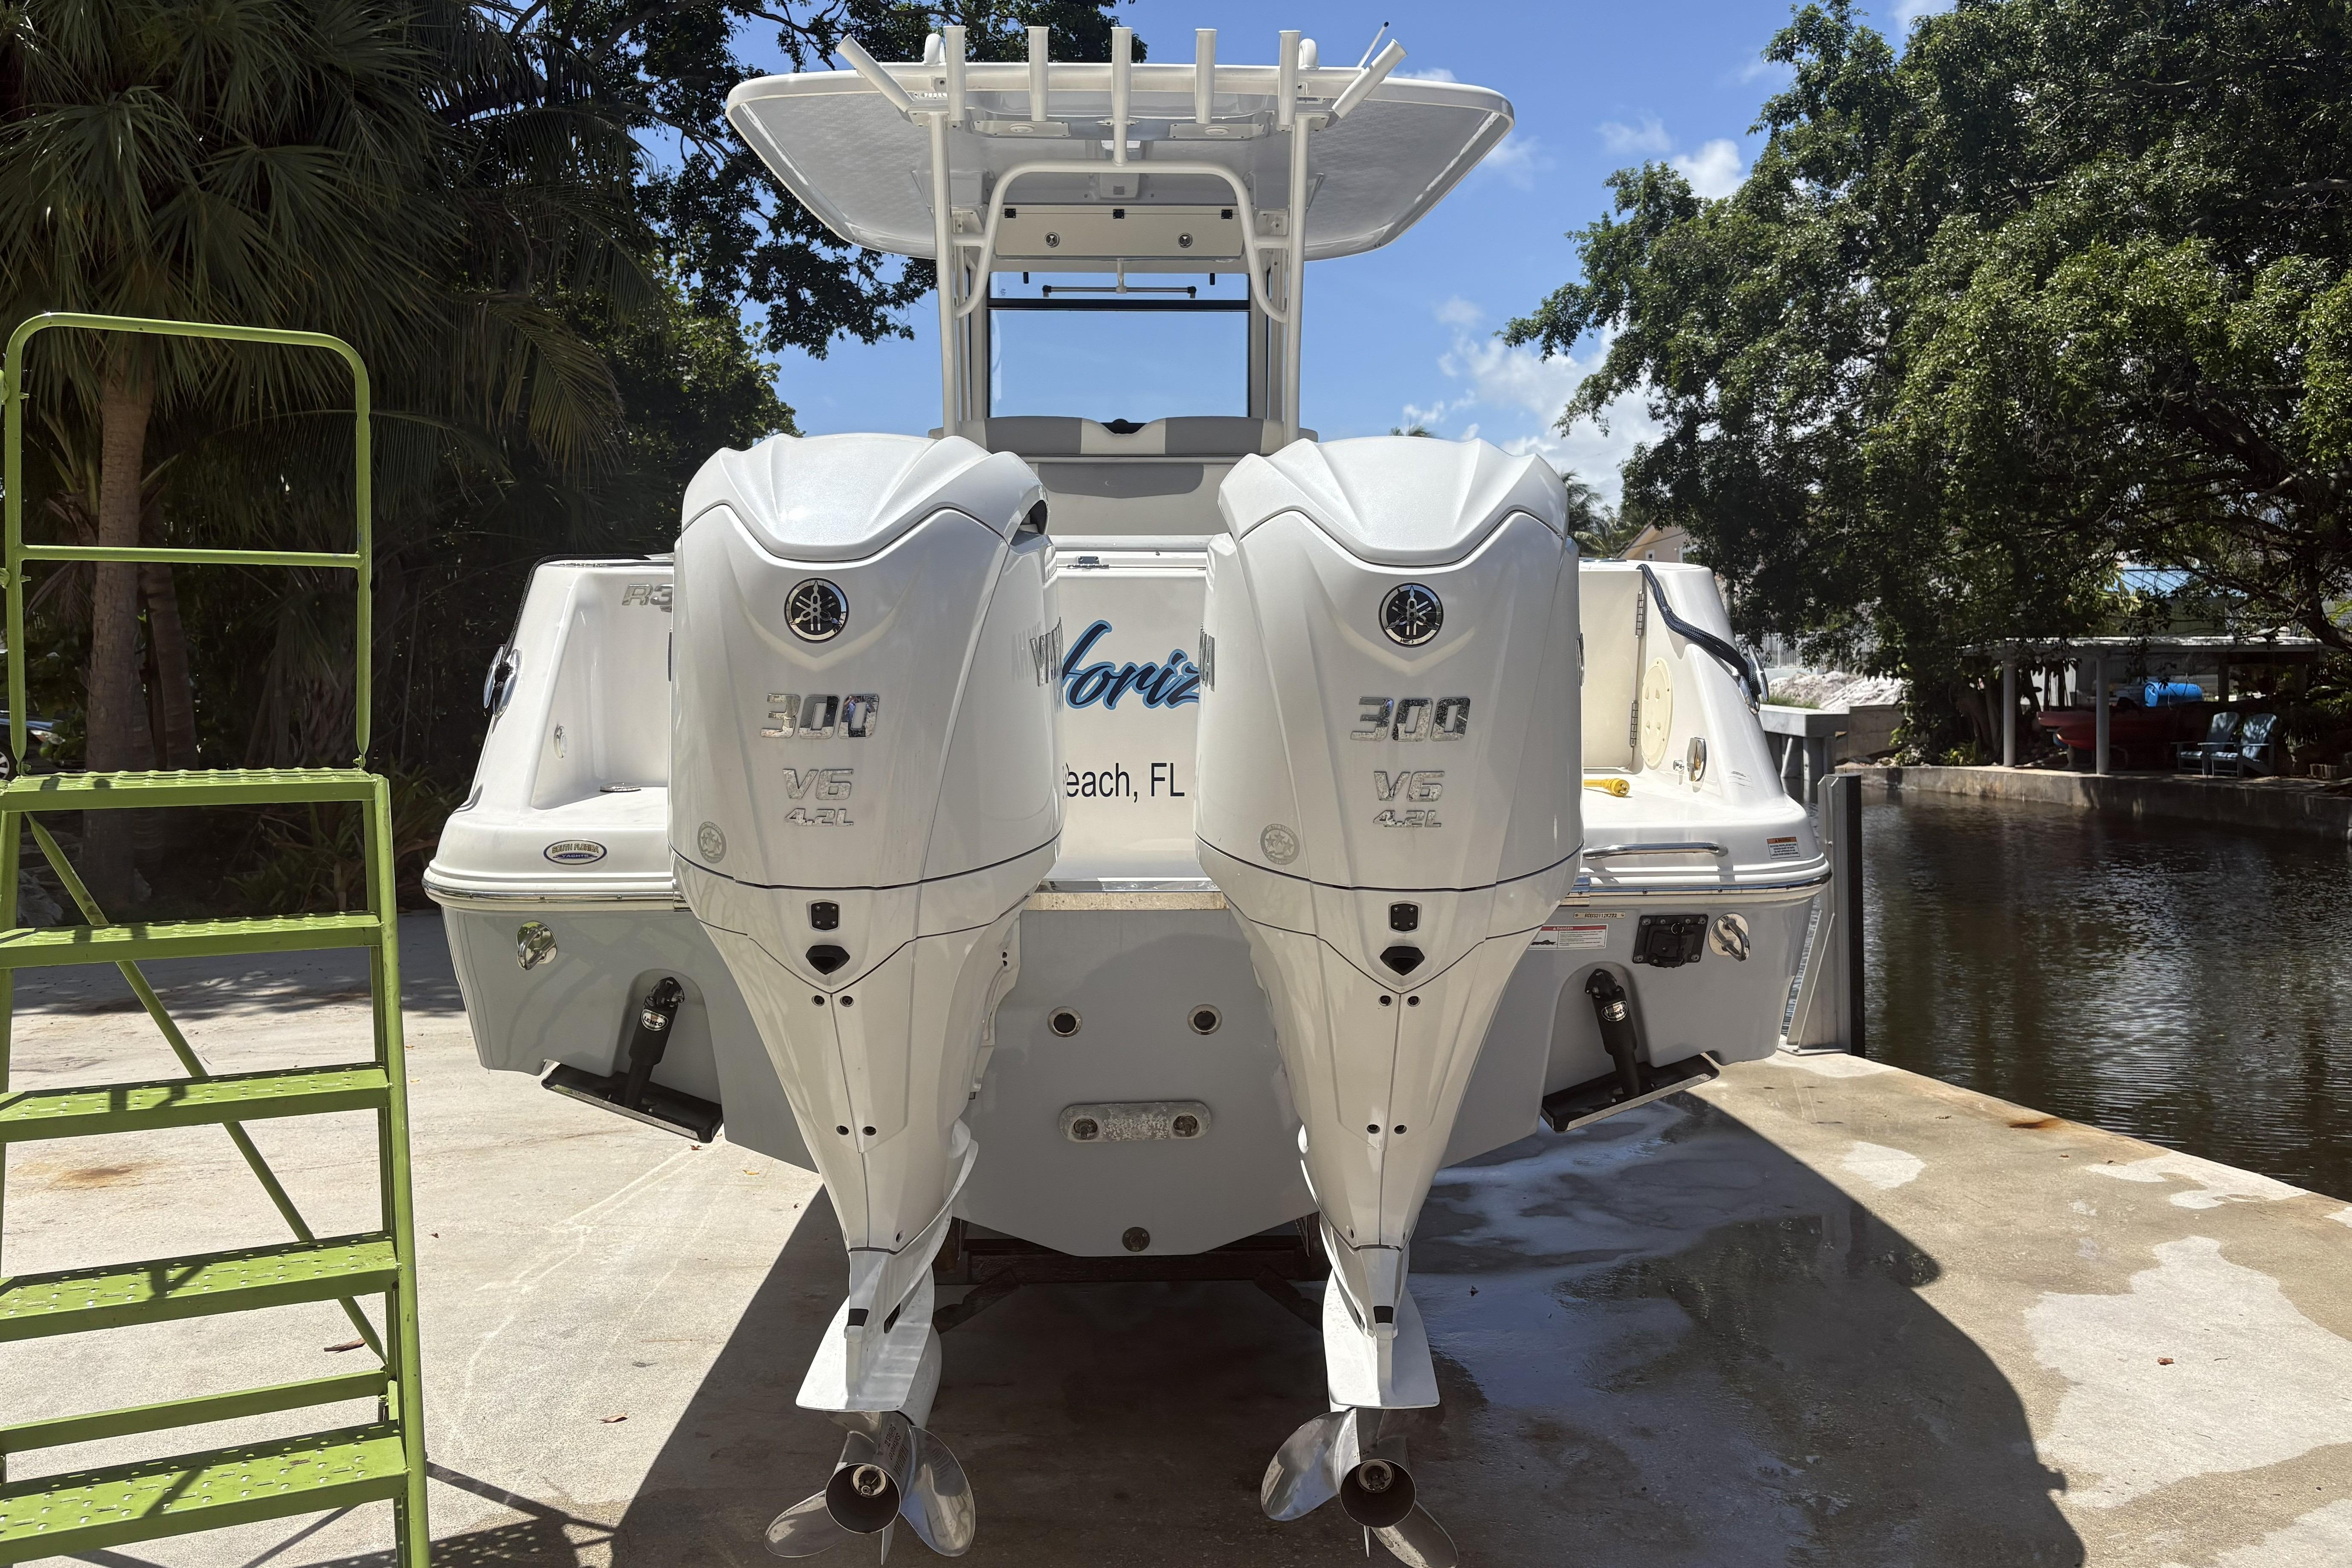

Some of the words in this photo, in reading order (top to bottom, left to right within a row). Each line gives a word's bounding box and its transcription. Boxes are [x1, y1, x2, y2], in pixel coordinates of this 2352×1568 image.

[760, 694, 879, 739] 300
[1350, 696, 1470, 742] 300
[783, 768, 853, 800] V6
[1066, 762, 1138, 803] each,
[1151, 762, 1185, 797] FL
[1374, 771, 1444, 802] V6
[785, 808, 853, 826] 4.2L
[1373, 810, 1441, 828] 4.2L
[552, 843, 573, 853] SOUTH
[574, 843, 599, 853] FLORIDA
[644, 1016, 663, 1026] LENCO
